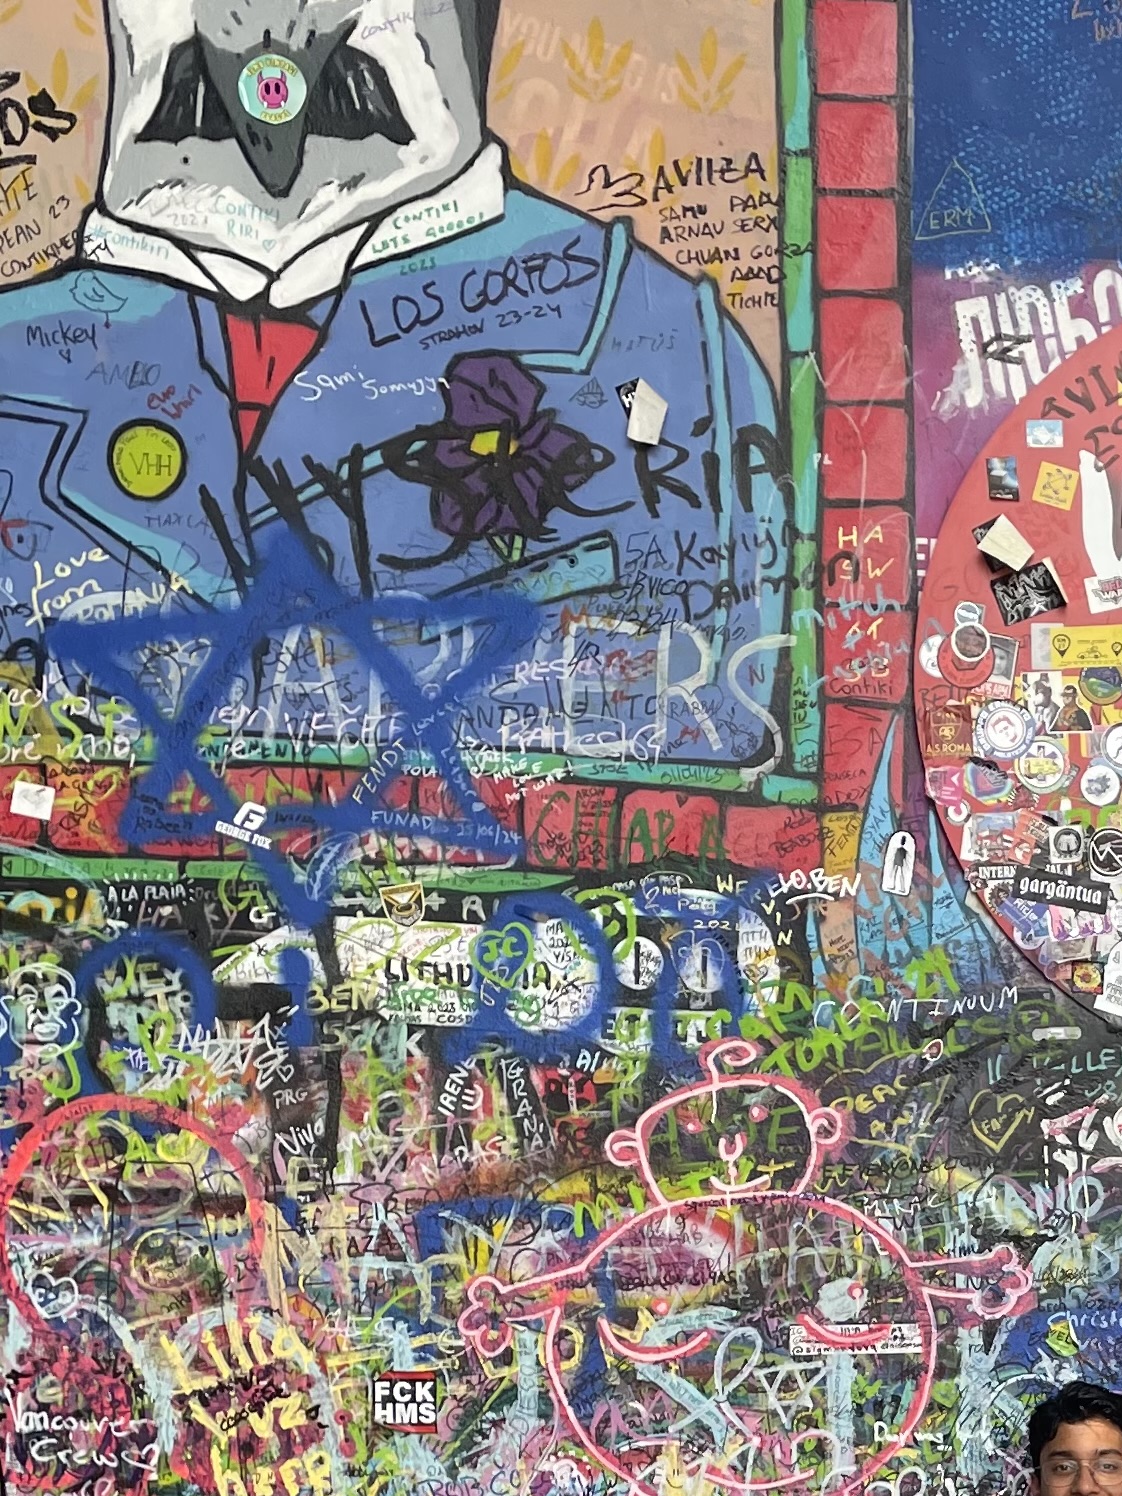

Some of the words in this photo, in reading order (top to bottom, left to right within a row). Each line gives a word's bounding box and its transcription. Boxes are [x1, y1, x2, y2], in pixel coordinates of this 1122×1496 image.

[359, 281, 444, 347] LOS
[128, 452, 174, 478] VHH
[215, 821, 251, 842] GEORGE
[252, 834, 272, 849] FOX
[374, 1381, 437, 1403] FCK
[374, 1402, 437, 1425] HMS
